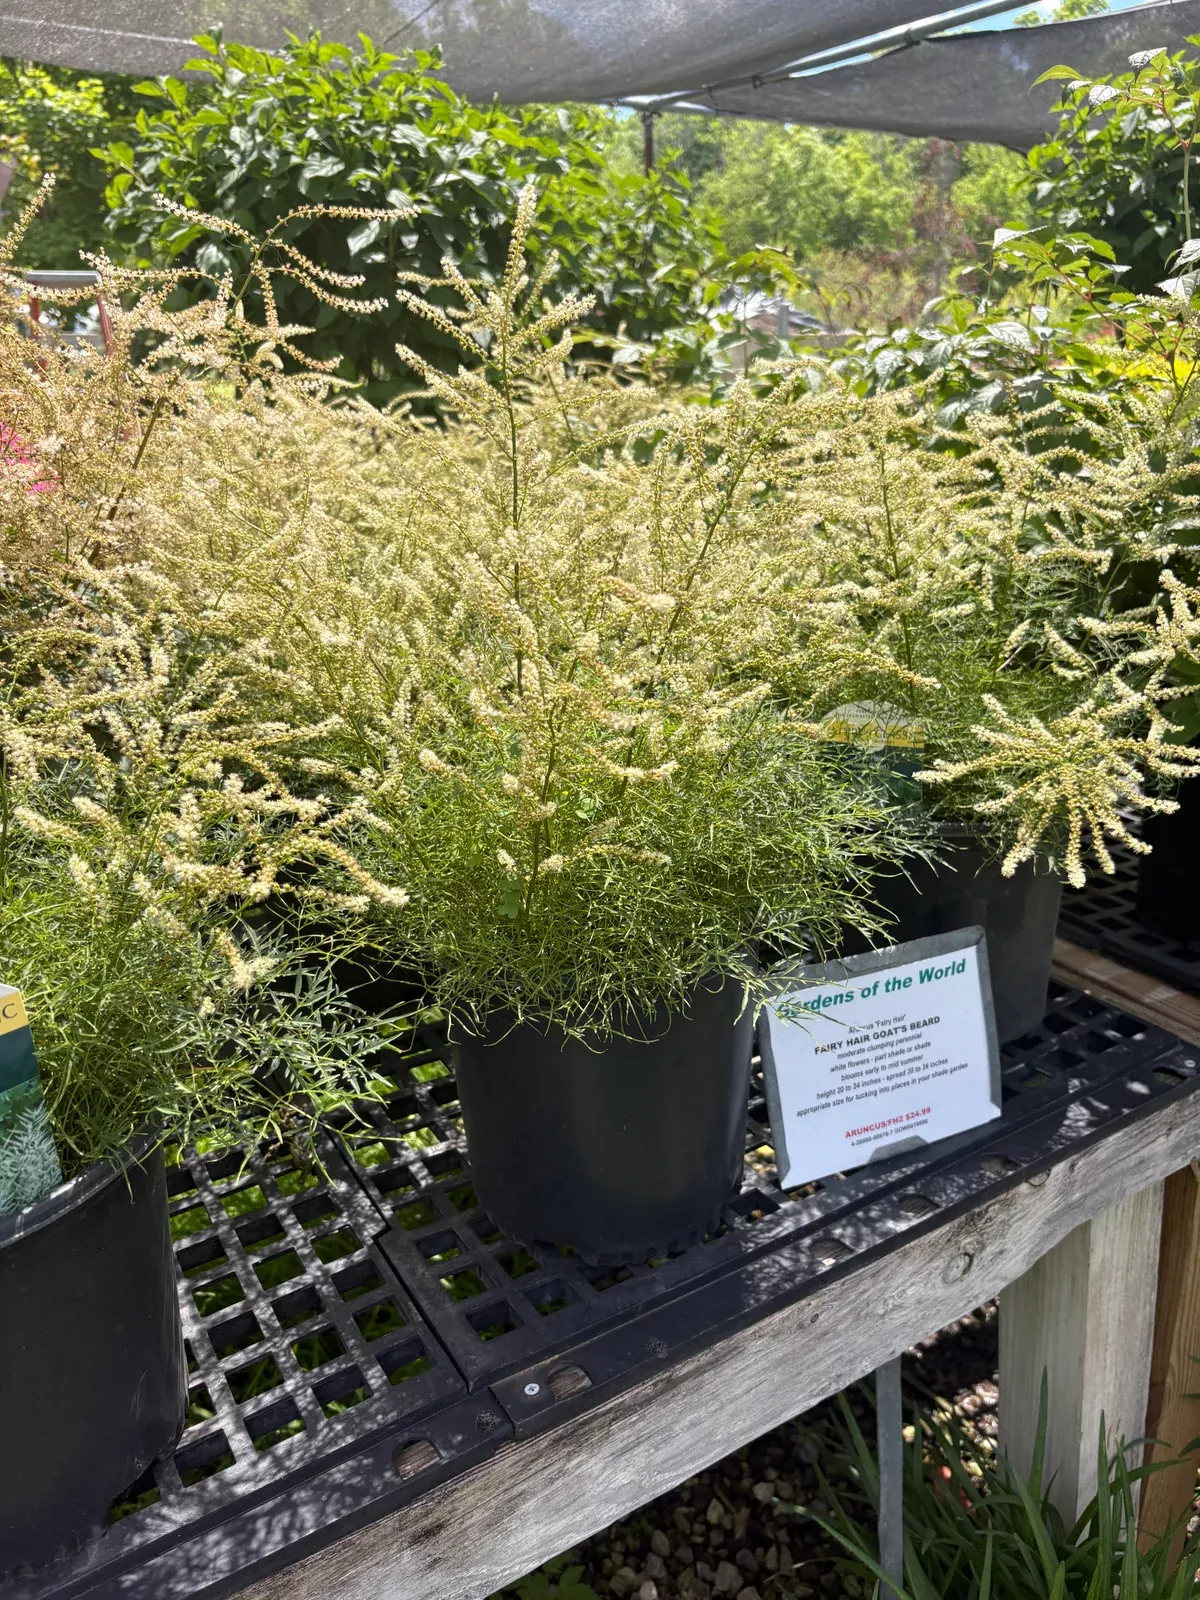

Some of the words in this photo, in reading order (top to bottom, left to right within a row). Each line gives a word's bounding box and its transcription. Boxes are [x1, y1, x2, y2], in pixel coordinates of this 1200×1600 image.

[861, 980, 880, 999] of
[885, 976, 912, 994] the
[919, 958, 966, 985] World
[814, 1040, 843, 1055] FAIRY
[846, 1034, 870, 1047] HAIR
[873, 1025, 907, 1040] GOAT'S
[910, 1015, 940, 1031] BEARD
[837, 1047, 866, 1060] moderate
[867, 1041, 894, 1055] clumping
[895, 1031, 922, 1046] perennial
[830, 1062, 846, 1074] white
[848, 1056, 870, 1069] flowers
[874, 1051, 887, 1063] part
[888, 1046, 906, 1058] shade
[914, 1040, 931, 1051] shade
[841, 1070, 863, 1082] blooms
[865, 1066, 879, 1078] early
[880, 1064, 887, 1072] to
[888, 1060, 899, 1070] mid
[900, 1054, 924, 1065] summer
[797, 1101, 831, 1118] appropriate
[832, 1097, 844, 1107] size
[845, 1094, 854, 1104] for
[855, 1089, 878, 1102] tucking
[879, 1085, 890, 1095] into
[891, 1080, 910, 1094] places
[911, 1077, 917, 1085] in
[918, 1073, 930, 1085] your
[932, 1068, 949, 1079] shade
[949, 1061, 968, 1075] garden
[816, 1088, 836, 1100] height
[837, 1085, 844, 1094] 20
[845, 1083, 852, 1091] to
[853, 1081, 860, 1090] 24
[861, 1077, 881, 1088] inches
[886, 1069, 906, 1082] spread
[907, 1066, 914, 1075] 20
[915, 1065, 921, 1073] to
[922, 1063, 929, 1072] 24
[930, 1058, 948, 1069] inches
[845, 1114, 904, 1138] ARUNCUS/FH2
[905, 1106, 931, 1121] $24.99
